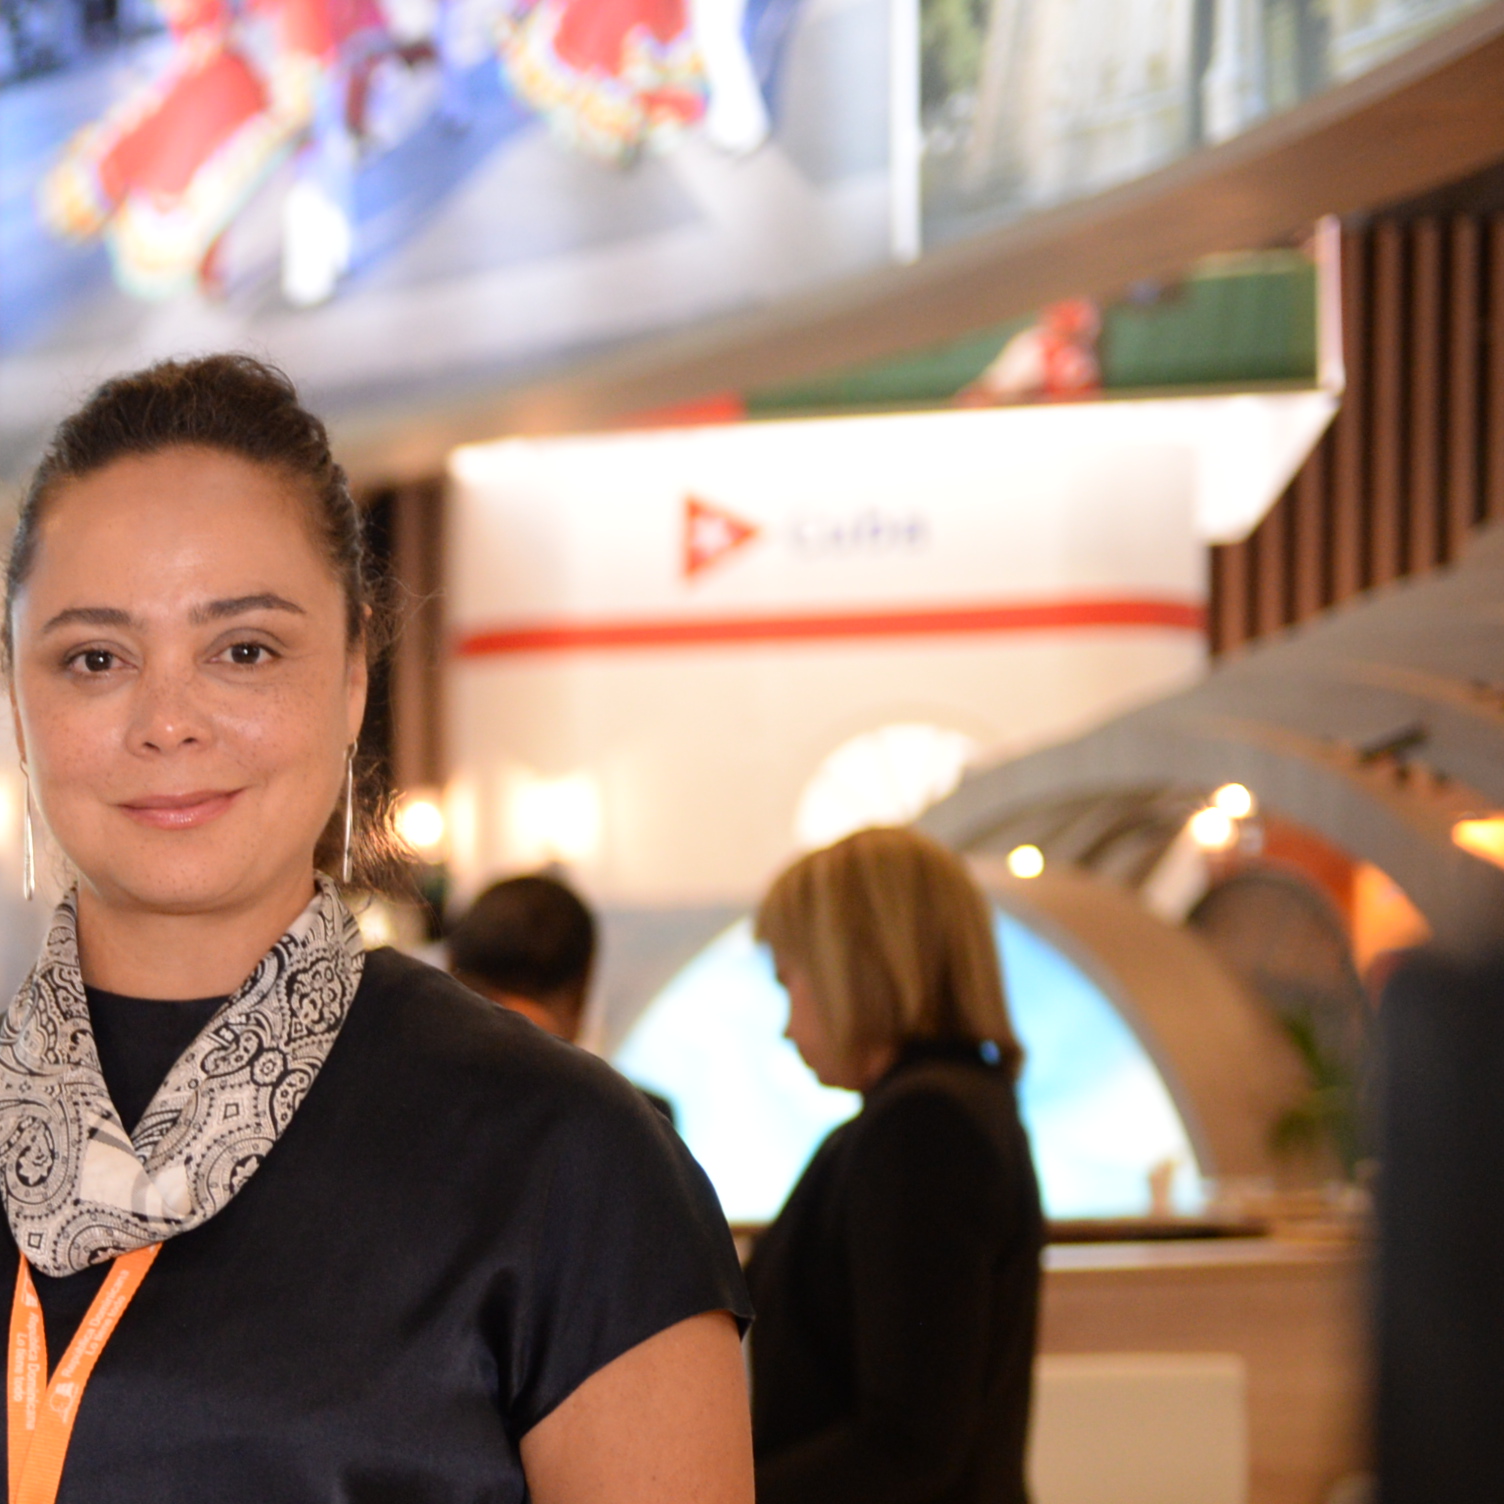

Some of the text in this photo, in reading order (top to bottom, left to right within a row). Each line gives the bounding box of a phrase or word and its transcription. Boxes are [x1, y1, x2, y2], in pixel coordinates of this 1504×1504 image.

[13, 1332, 28, 1402] Lo tiene todo
[84, 1342, 99, 1356] Lo
[25, 1363, 40, 1430] Dominicana
